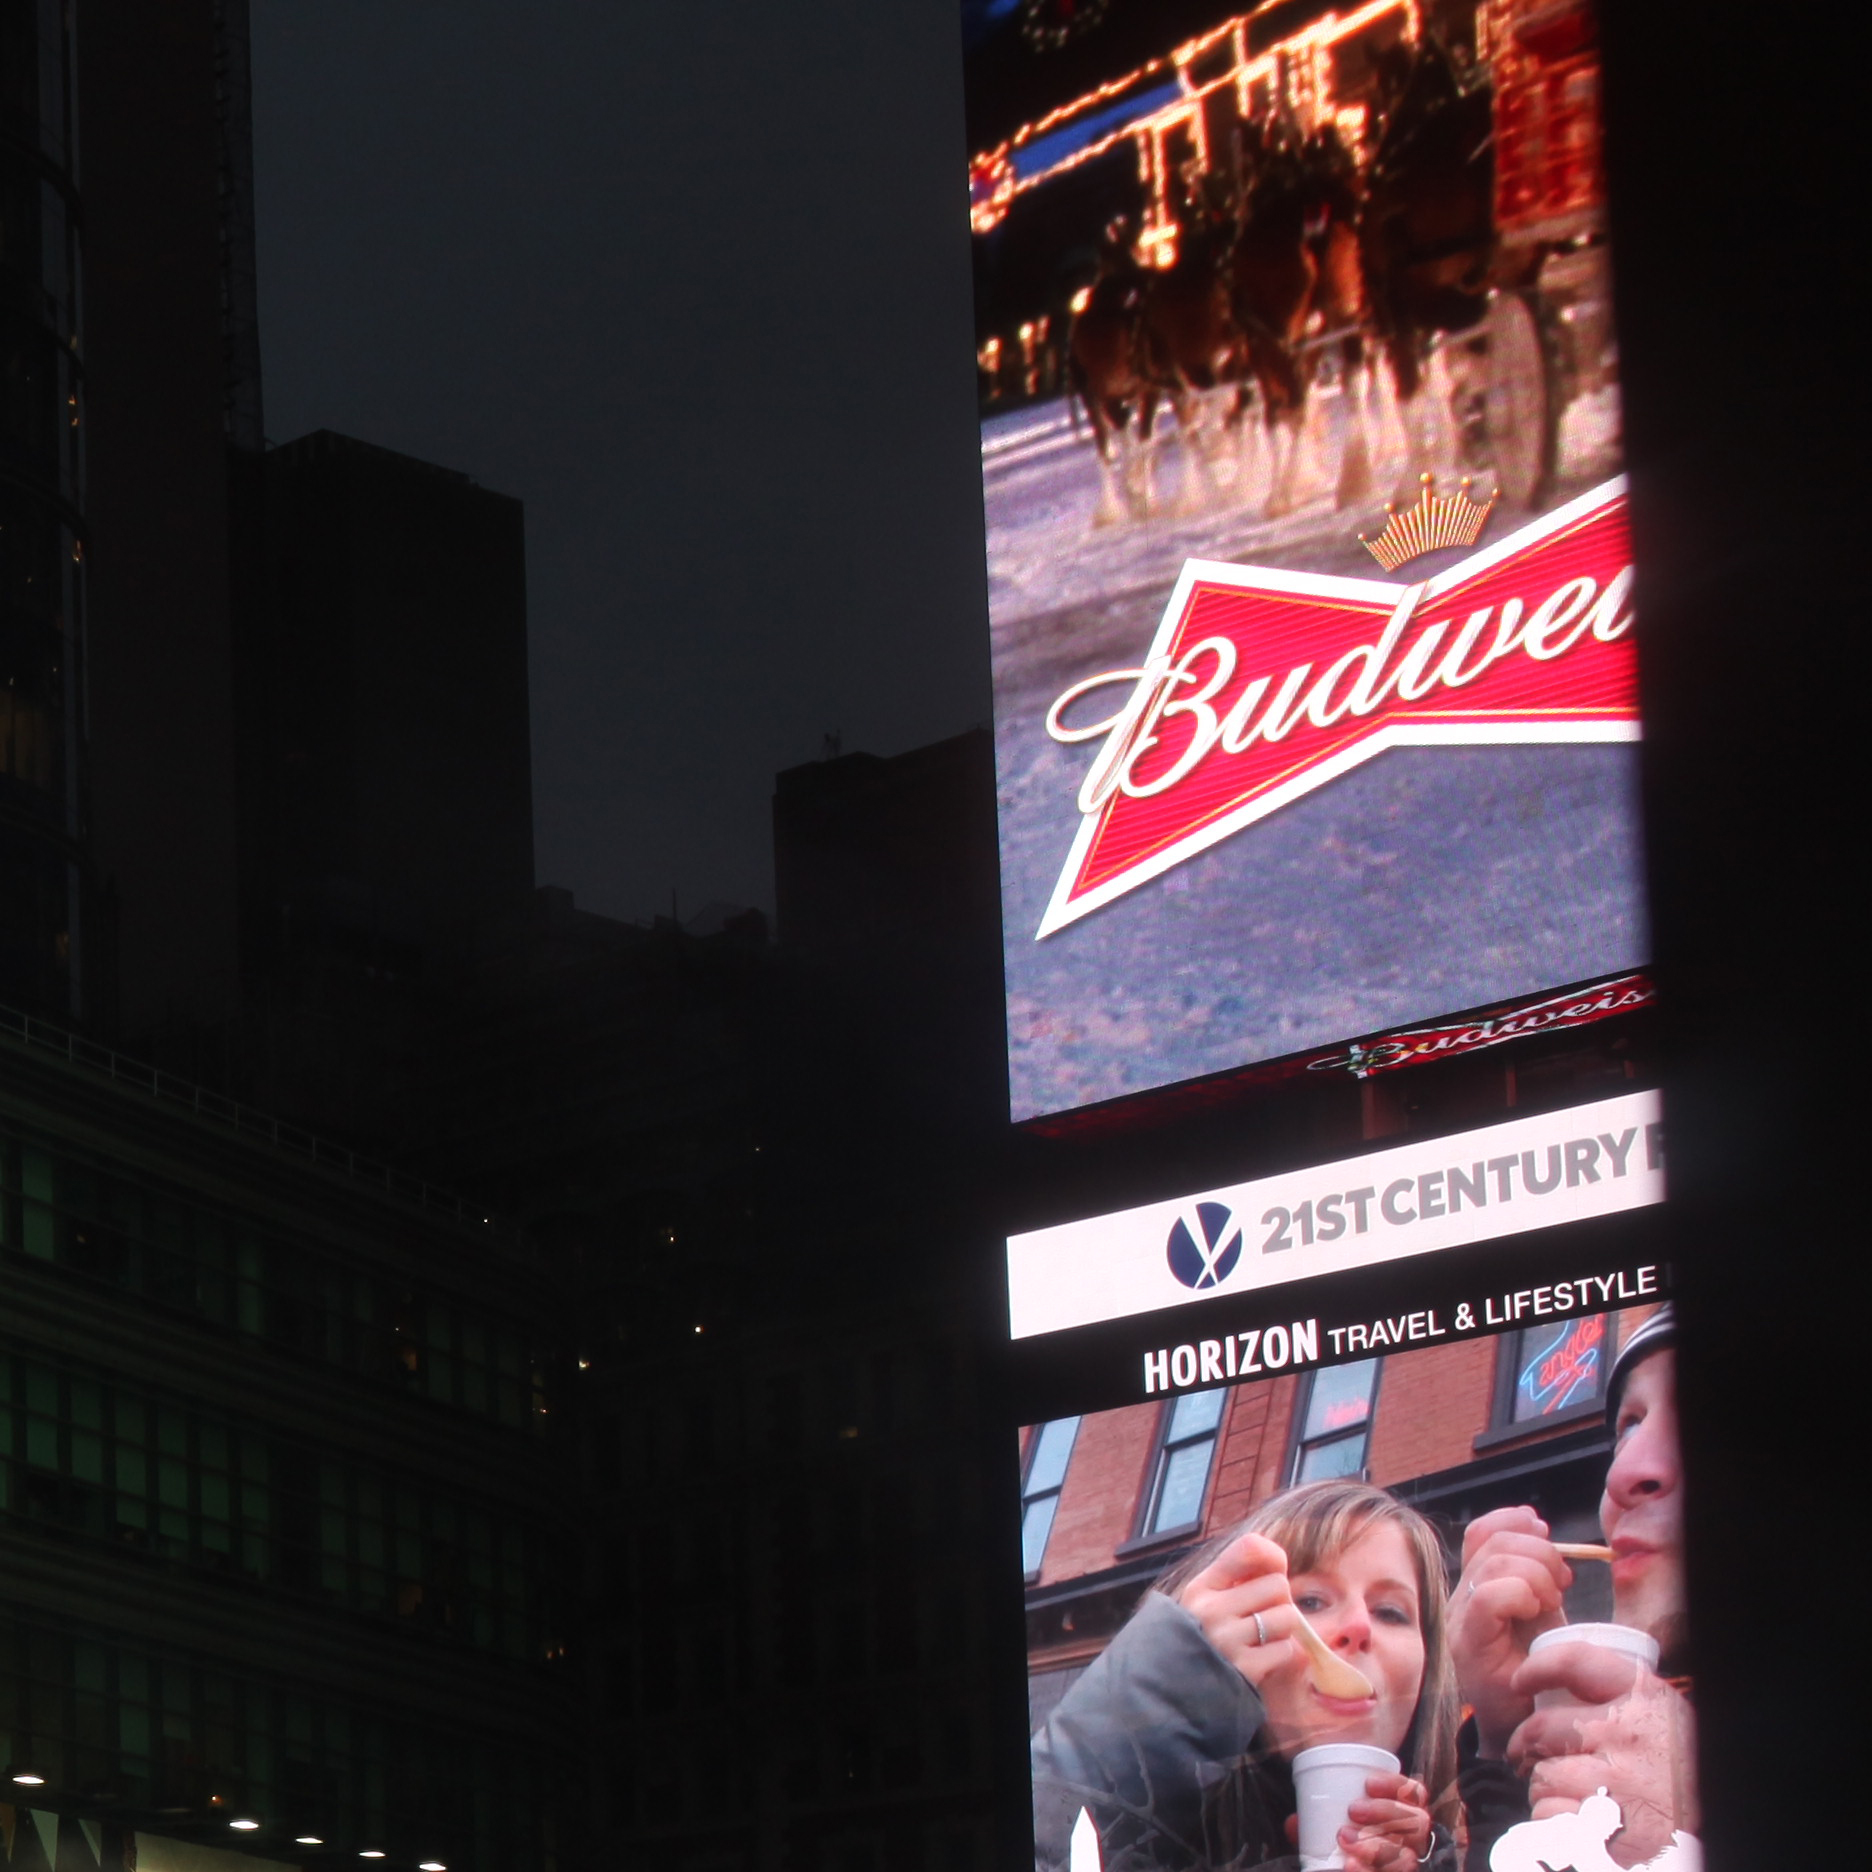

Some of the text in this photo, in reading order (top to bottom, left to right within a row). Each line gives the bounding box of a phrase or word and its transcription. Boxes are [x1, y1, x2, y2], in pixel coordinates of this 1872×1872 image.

[1260, 1187, 1375, 1255] 21ST
[1380, 1127, 1637, 1225] CENTURY
[1144, 1265, 1657, 1393] HORIZON TRAVEL & LIFESTYLE
